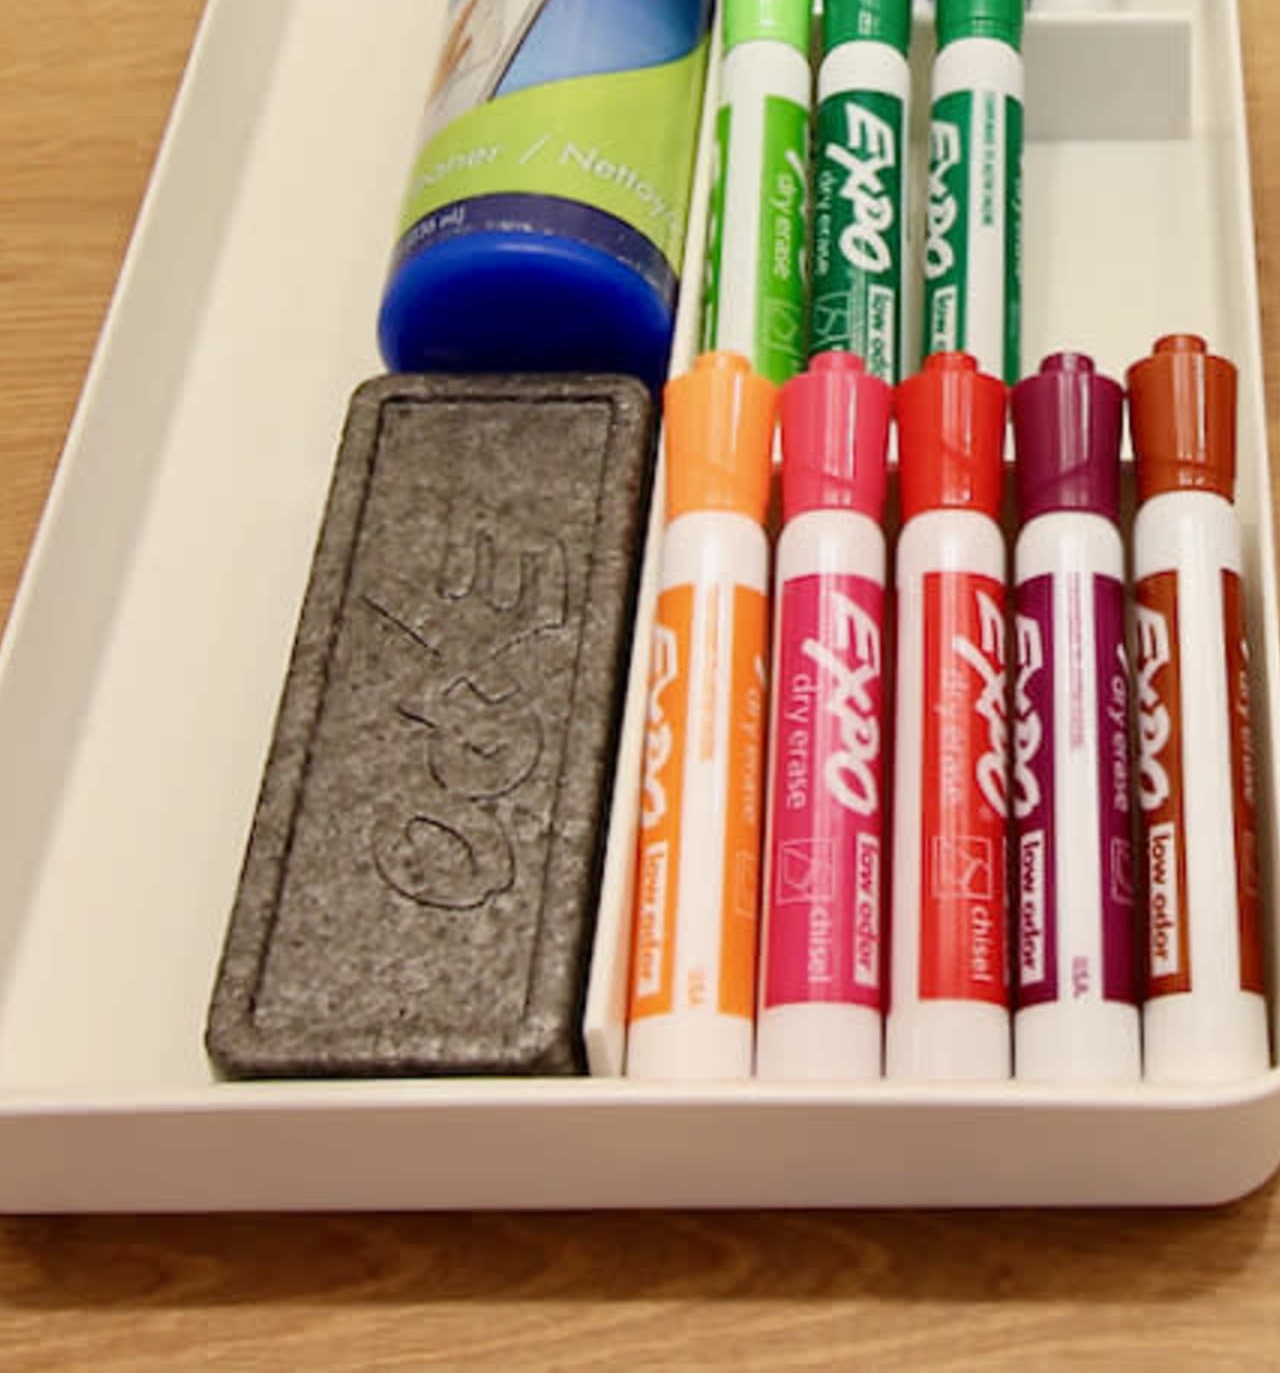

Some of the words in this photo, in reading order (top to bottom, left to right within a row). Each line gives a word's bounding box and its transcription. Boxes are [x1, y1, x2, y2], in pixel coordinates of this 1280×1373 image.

[771, 172, 796, 212] dry
[825, 102, 896, 273] EXPO
[774, 215, 791, 280] erase
[785, 671, 815, 722] dry
[801, 593, 881, 817] EXPO
[952, 589, 1008, 819] EXPO
[786, 729, 810, 809] erase
[860, 840, 878, 890] low
[1023, 840, 1041, 893] low
[1151, 833, 1171, 885] low
[856, 901, 877, 970] odor
[972, 905, 994, 982] chisel
[1023, 900, 1041, 970] odor
[1152, 892, 1175, 960] odor
